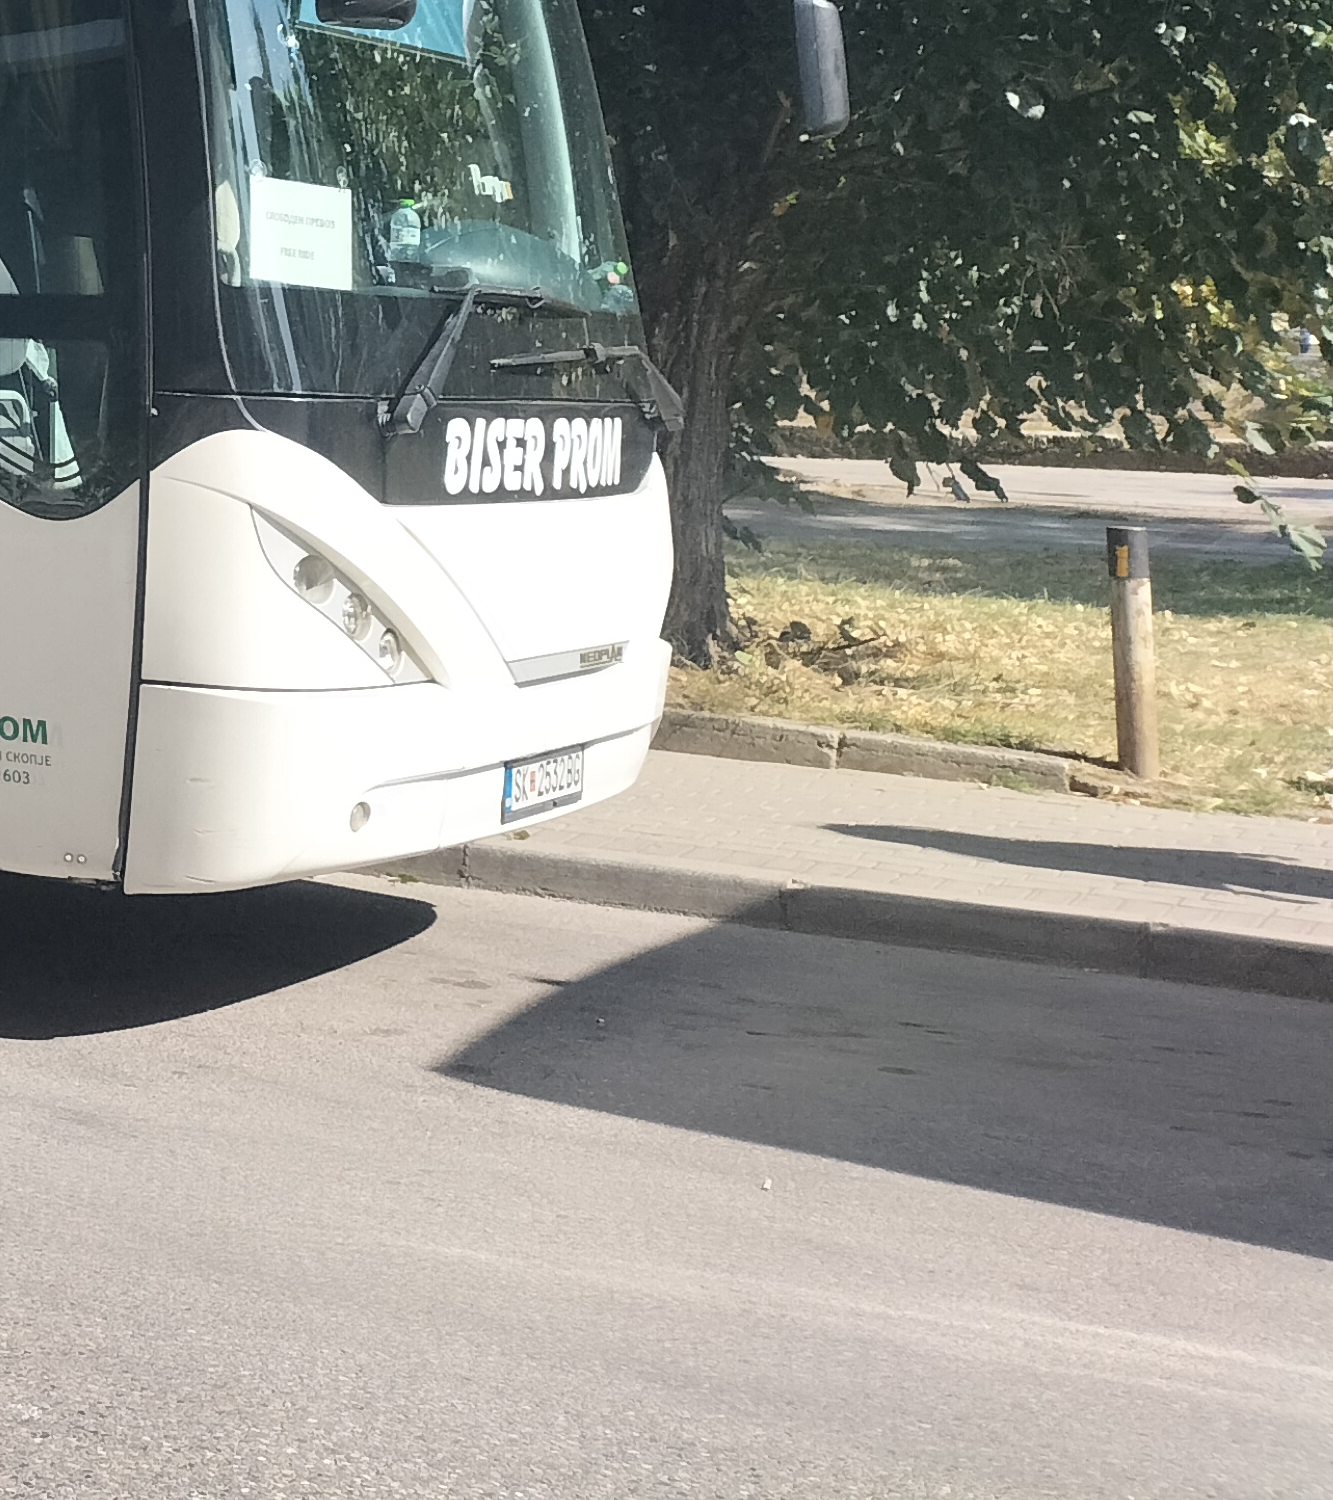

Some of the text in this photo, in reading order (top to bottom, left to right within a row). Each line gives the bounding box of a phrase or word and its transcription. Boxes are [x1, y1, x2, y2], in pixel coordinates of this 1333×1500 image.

[444, 417, 623, 496] BISER PROM
[5, 751, 52, 767] СКОПЈЕ
[2, 768, 30, 785] 603
